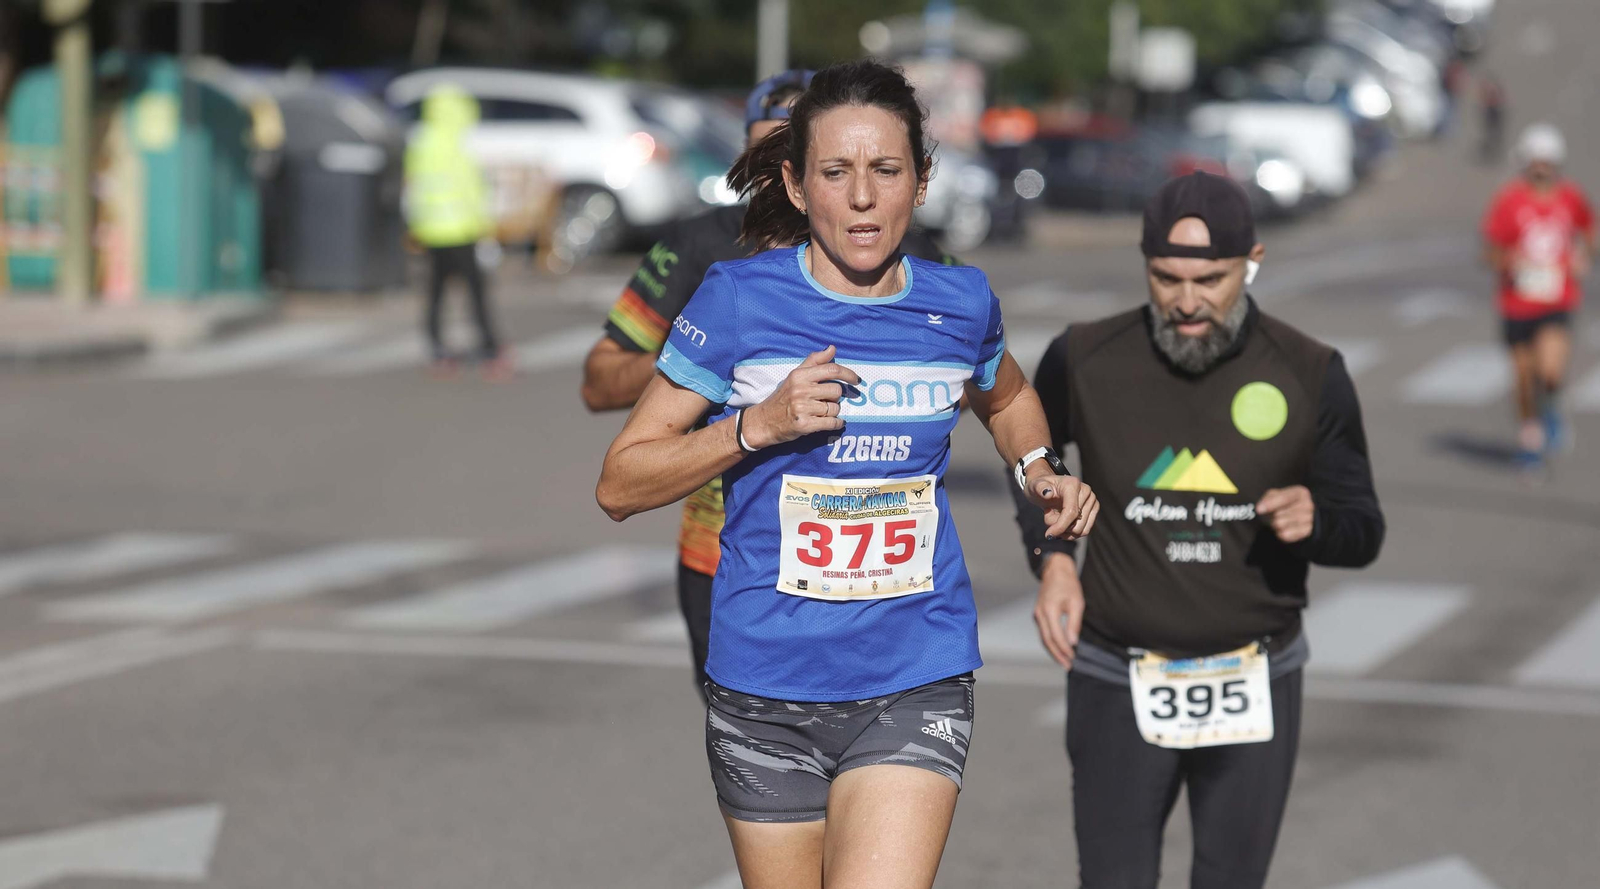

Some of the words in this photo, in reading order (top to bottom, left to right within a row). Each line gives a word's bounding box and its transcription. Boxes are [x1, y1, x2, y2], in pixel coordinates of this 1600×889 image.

[673, 313, 707, 346] sam
[840, 379, 954, 408] sam
[827, 435, 912, 463] 226ERS
[785, 494, 810, 502] EVOS
[811, 493, 863, 512] CARRERA
[864, 490, 908, 510] NAVIDAD
[854, 486, 880, 495] EDICIÓN
[873, 508, 909, 517] ALGECIRAS
[1194, 496, 1256, 527] Homes
[796, 519, 917, 570] 375
[822, 570, 848, 579] RESINAS
[868, 568, 894, 577] CRISTINA
[1149, 679, 1249, 720] 395
[921, 726, 956, 745] adidas
